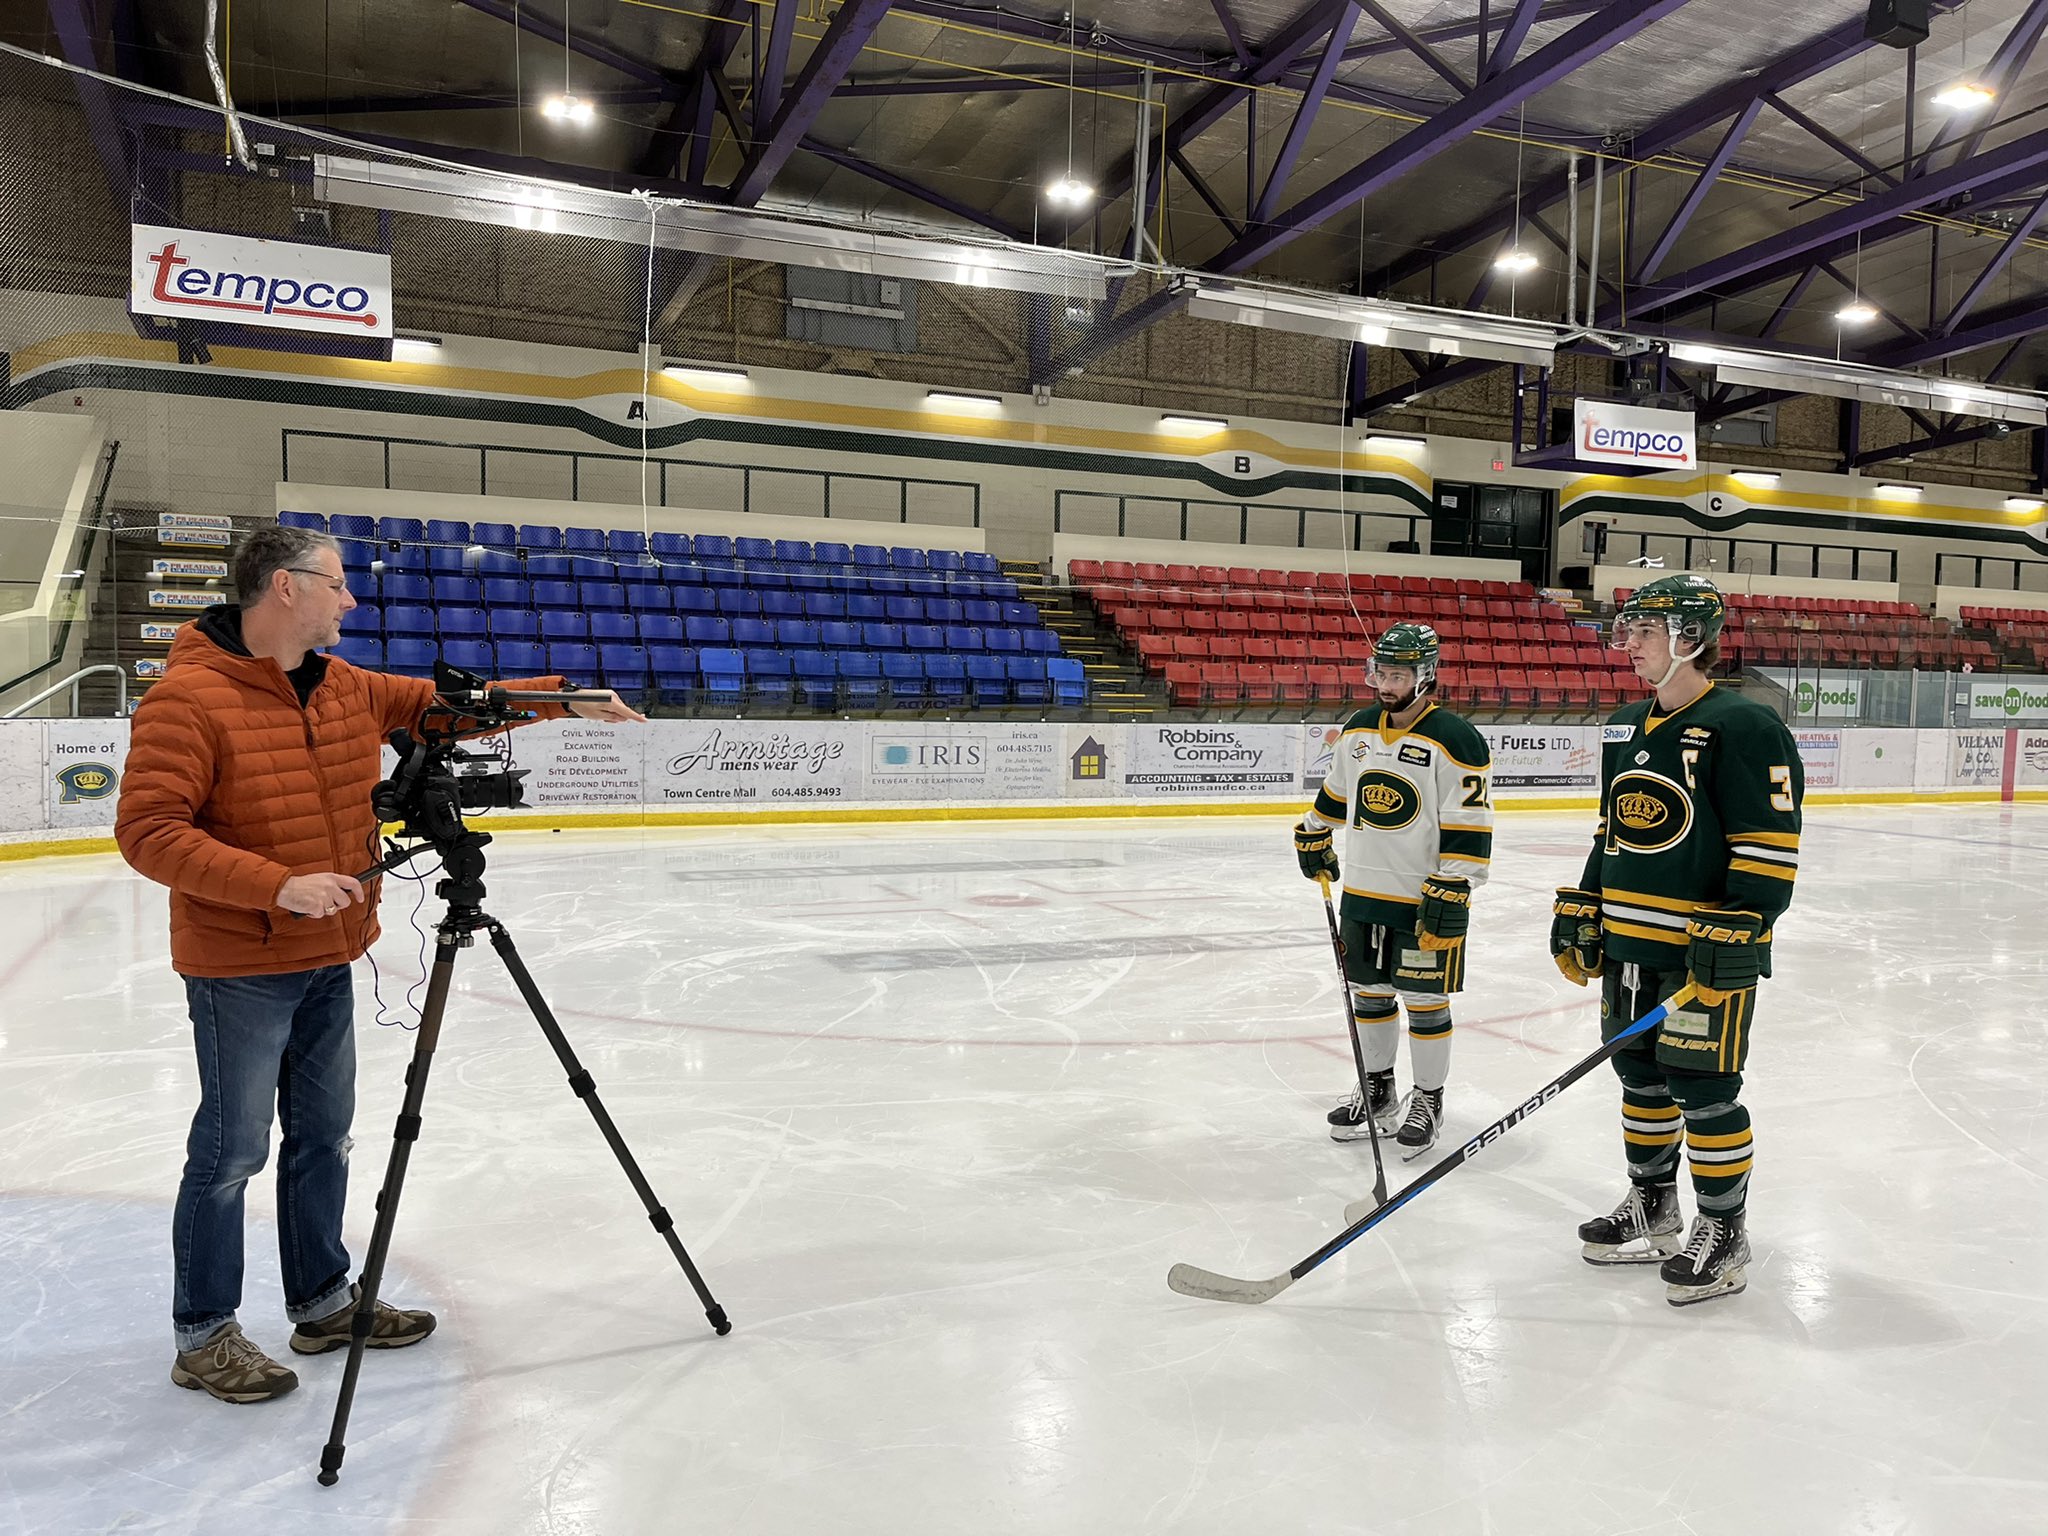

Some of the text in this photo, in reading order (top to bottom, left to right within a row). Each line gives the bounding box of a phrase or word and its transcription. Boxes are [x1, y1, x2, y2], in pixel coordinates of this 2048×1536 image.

[146, 240, 377, 323] tempco
[627, 401, 648, 421] A
[1582, 409, 1685, 458] tempco
[1235, 456, 1250, 473] B
[1711, 497, 1722, 511] C
[1012, 731, 1038, 739] iris.ca
[1159, 729, 1235, 747] Robbins
[56, 742, 115, 754] Home of
[1234, 740, 1243, 749] &
[1501, 735, 1546, 750] FUELS
[1551, 738, 1575, 750] LTD.
[1957, 736, 2003, 748] VILLANI
[666, 728, 844, 775] Armitage
[996, 744, 1052, 753] 604.485.7115
[918, 745, 980, 765] IRIS
[1174, 746, 1263, 768] Company
[1511, 755, 1543, 766] Future
[720, 761, 799, 771] mens wear
[1131, 774, 1289, 783] ACCOUNTING TAX ESTATES
[1804, 776, 1834, 784] 89-0030
[663, 787, 841, 798] Town Centre Mall 604.485.9493
[1155, 784, 1266, 792] robbinsandco.ca
